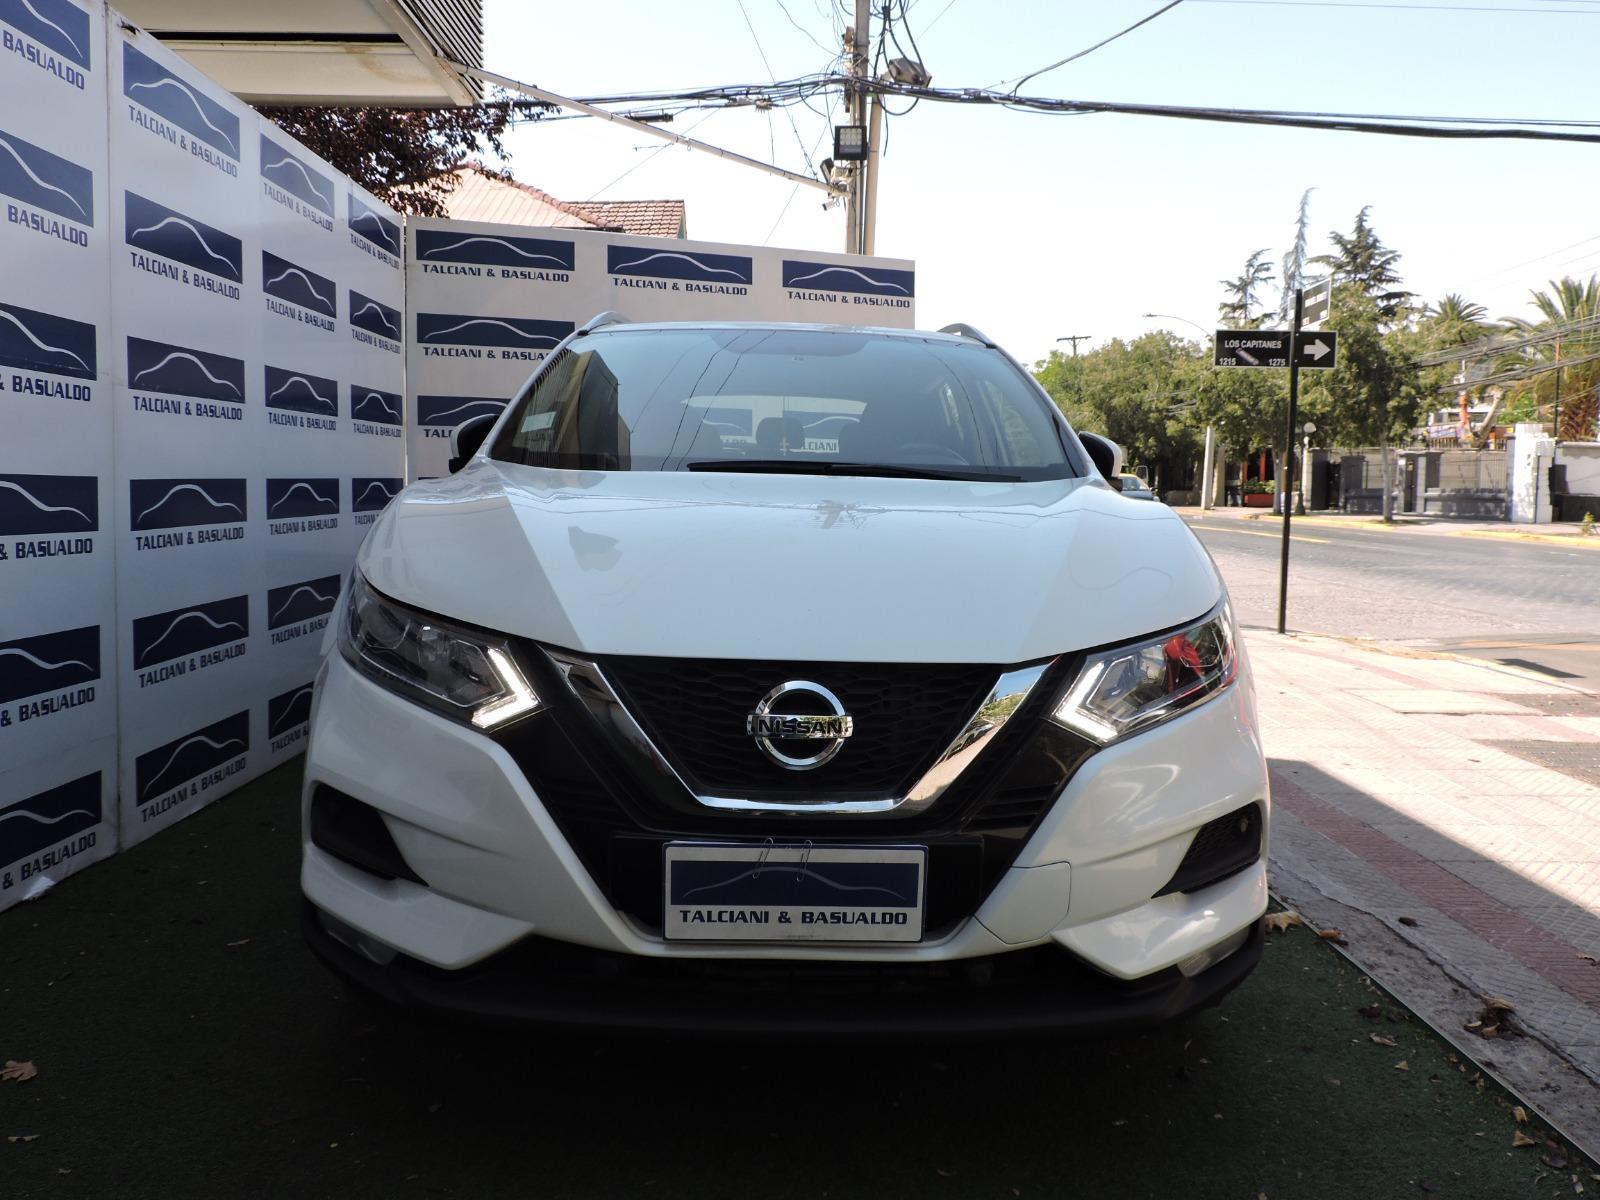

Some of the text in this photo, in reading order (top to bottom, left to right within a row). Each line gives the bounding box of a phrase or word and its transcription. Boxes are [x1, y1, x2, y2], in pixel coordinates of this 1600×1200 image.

[3, 30, 85, 90] BASUALDO
[129, 105, 237, 178] TALCIANI & BASUALDO
[8, 204, 88, 247] BASUALDO
[130, 252, 240, 300] TALCIANI & BASUALDO
[422, 264, 569, 283] TALCIANI & BASUALDO
[613, 277, 748, 296] TALCIANI & BASUALDO
[787, 291, 910, 308] TALCIANI & BASUALDO
[266, 299, 296, 319] TALCIANI
[305, 313, 335, 332] BASUALDO
[423, 347, 547, 361] TALCIANI & BASUA
[1224, 340, 1282, 349] LOS CAPITANES
[1219, 358, 1286, 366] 1215 1275
[12, 375, 91, 401] BASUALDO
[133, 396, 242, 420] TALCIANI & BASUALDO
[268, 412, 298, 428] TALCIANI
[306, 417, 337, 431] BASUALDO
[16, 538, 93, 559] BASUALDO
[136, 527, 244, 551] TALCIANI & BASUALDO
[139, 643, 246, 688] TALCIANI & BASUALDO
[0, 687, 95, 727] & BASUALDO
[758, 718, 843, 736] NISSAN
[141, 757, 246, 823] TALCIANI & BASUALDO
[2, 832, 96, 890] & BASUALDO
[680, 910, 908, 925] TALCIANI & BASUALDO
